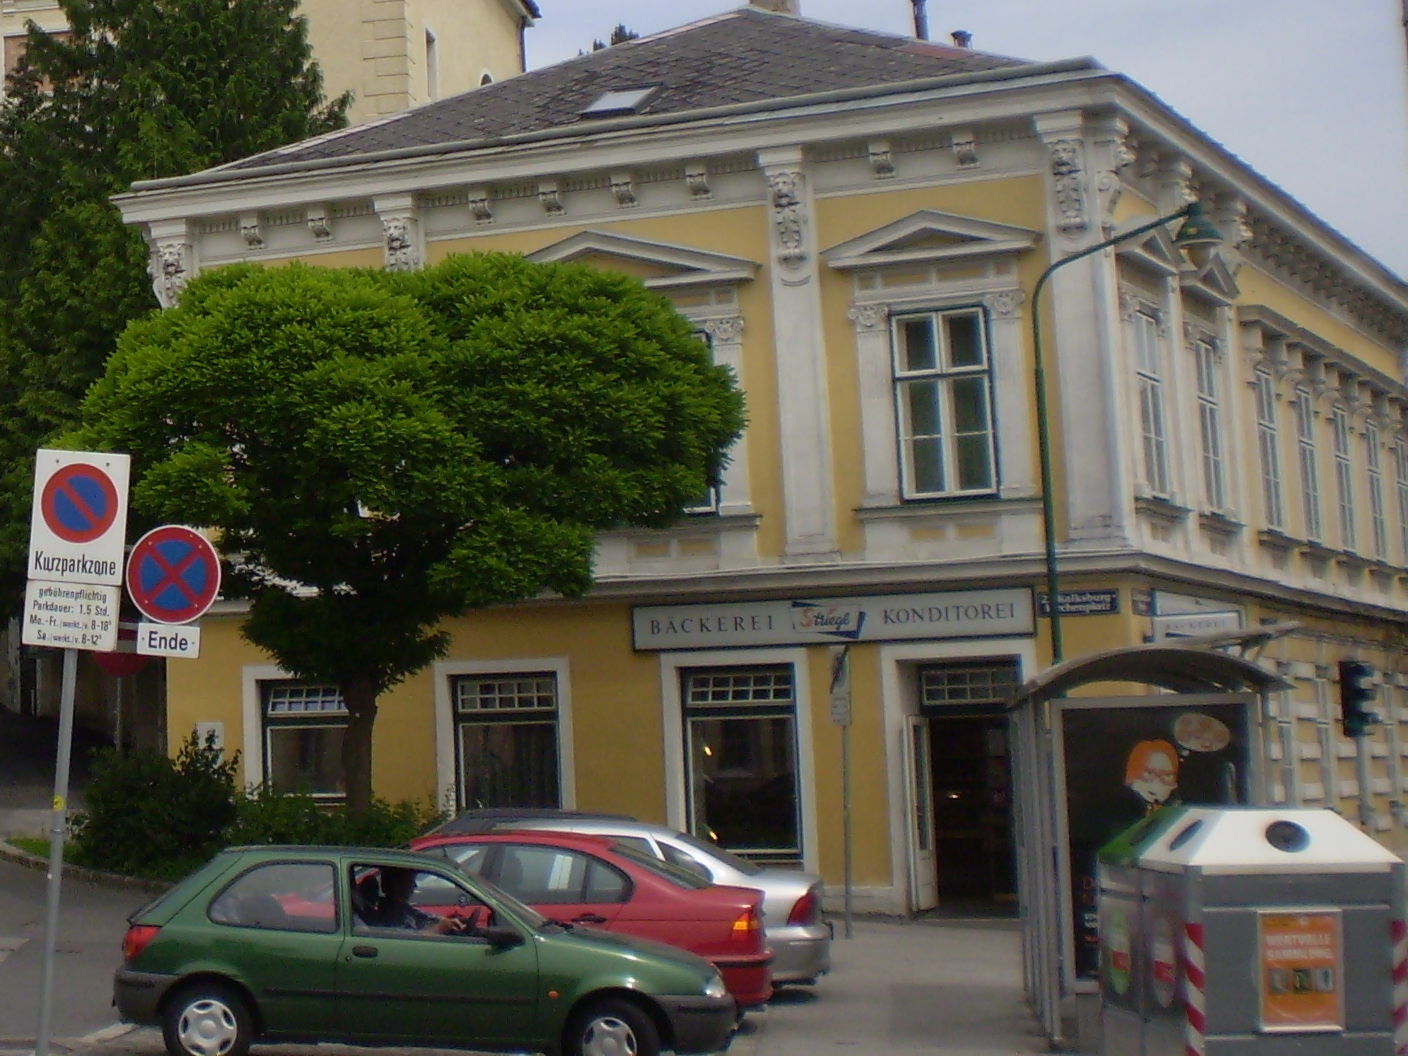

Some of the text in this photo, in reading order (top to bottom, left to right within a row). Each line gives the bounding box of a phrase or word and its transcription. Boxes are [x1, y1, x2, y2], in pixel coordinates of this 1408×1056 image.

[34, 550, 116, 576] Kurzparkzone
[38, 586, 107, 604] gebührenpflichtig
[32, 600, 74, 614] Parkdauer:
[649, 614, 775, 636] BÄCKEREI
[882, 602, 1016, 625] KONDITOREI
[148, 630, 188, 651] Ende
